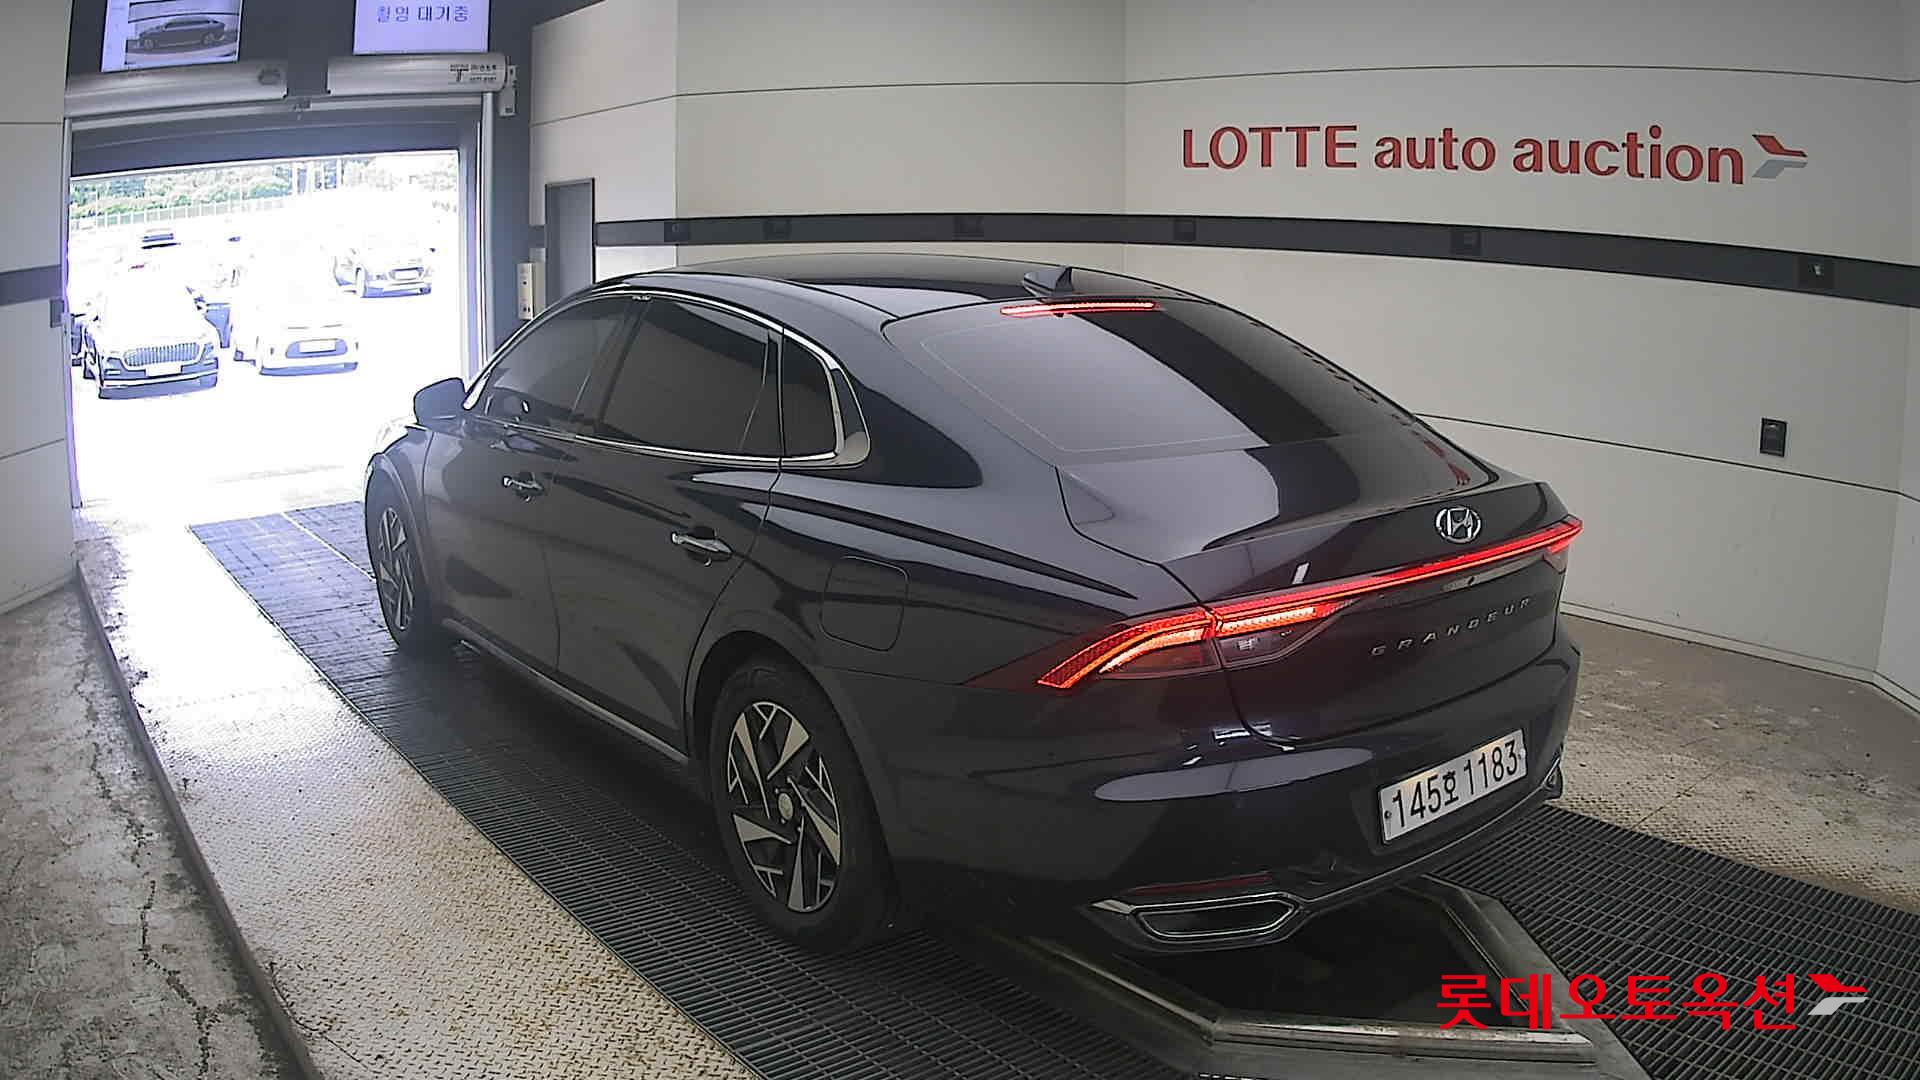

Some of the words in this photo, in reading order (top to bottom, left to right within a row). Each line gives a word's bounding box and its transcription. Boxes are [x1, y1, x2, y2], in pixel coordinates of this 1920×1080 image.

[418, 6, 468, 22] 대기중
[1183, 125, 1358, 169] LOTTE
[1375, 127, 1496, 171] auto
[1513, 125, 1744, 184] auction
[1370, 596, 1530, 656] GRANDEUR
[1392, 770, 1459, 828] 145호
[1463, 739, 1518, 796] 1183
